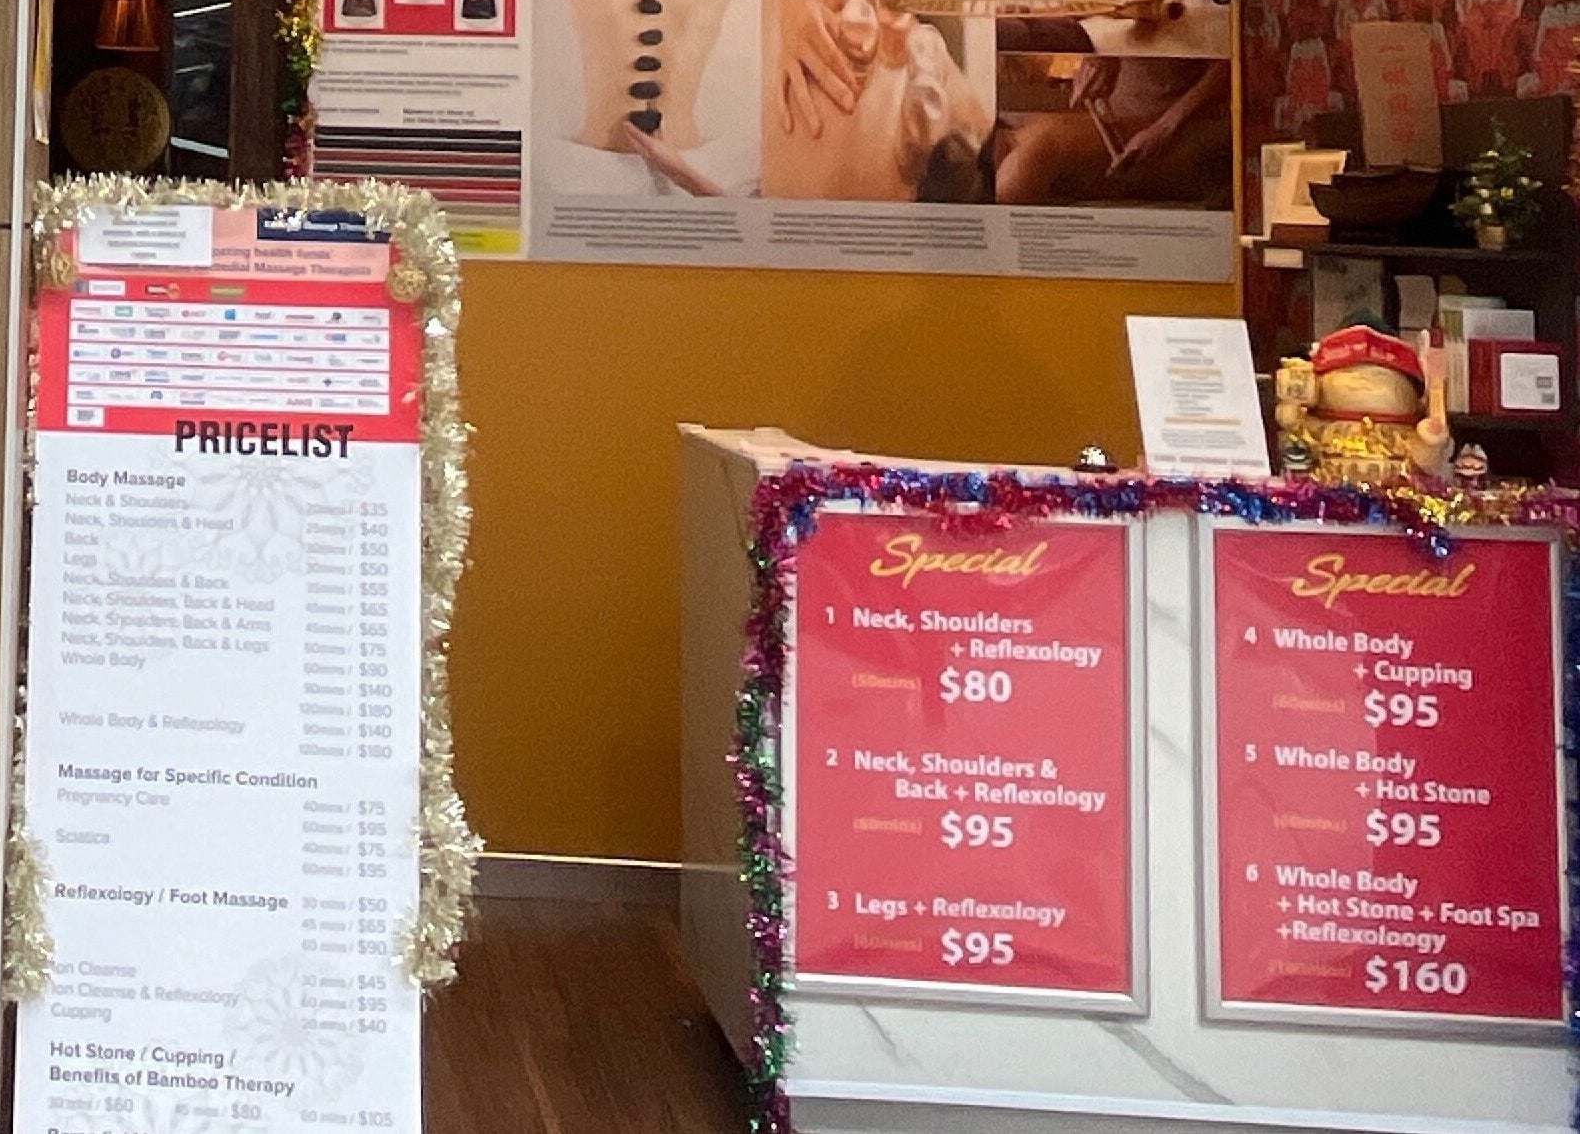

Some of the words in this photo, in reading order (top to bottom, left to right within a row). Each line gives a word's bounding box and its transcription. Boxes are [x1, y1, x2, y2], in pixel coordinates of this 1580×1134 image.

[175, 420, 354, 458] PRICELIST
[66, 469, 109, 487] Body
[114, 471, 186, 488] Massage
[870, 533, 1048, 589] Special
[1291, 552, 1476, 609] Special
[826, 607, 834, 624] 1
[853, 607, 916, 633] Neck,
[920, 610, 1034, 634] Shoulders
[950, 643, 964, 657] +
[970, 639, 1102, 668] Reflexology
[1244, 626, 1257, 643] 4
[1273, 628, 1347, 652] Whole
[1354, 632, 1413, 659] Body
[940, 666, 1012, 703] $80
[1353, 663, 1367, 679] +
[1374, 660, 1472, 689] Cupping
[1364, 689, 1439, 728] $95
[58, 764, 132, 784] Massage
[137, 767, 160, 782] for
[165, 768, 232, 786] Specific
[235, 771, 318, 788] Condition
[826, 749, 838, 766] 2
[854, 750, 916, 775] Neck,
[921, 752, 1035, 779] Shoulders
[1040, 759, 1058, 779] &
[1245, 744, 1257, 762] 5
[1274, 745, 1349, 770] Whole
[1356, 750, 1415, 779] Body
[57, 788, 133, 808] Pregnancy
[135, 790, 171, 806] Care
[895, 779, 948, 799] Back
[955, 787, 968, 800] +
[974, 782, 1106, 812] Reflexology
[1355, 783, 1369, 798] +
[1376, 779, 1419, 802] Hot
[1423, 781, 1490, 805] Stone
[940, 810, 1014, 850] $95
[1365, 809, 1441, 847] $95
[54, 883, 154, 906] Reflexology
[170, 888, 208, 906] Foot
[212, 891, 289, 911] Massage
[1246, 864, 1258, 881] 6
[1276, 865, 1350, 890] Whole
[1357, 871, 1418, 898] Body
[827, 891, 840, 910] 3
[855, 893, 908, 920] Legs
[914, 901, 927, 916] +
[932, 897, 1066, 928] Reflexology
[1276, 897, 1291, 912] +
[1297, 895, 1339, 917] Hot
[1346, 897, 1413, 921] Stone
[1420, 907, 1434, 922] +
[1440, 903, 1493, 925] Foot
[1497, 905, 1539, 931] Spa
[940, 927, 1014, 966] $95
[1365, 954, 1468, 993] $160
[50, 1041, 81, 1058] Hot
[85, 1043, 135, 1060] Stone
[151, 1047, 224, 1068] Cupping
[49, 1065, 120, 1085] Benefits
[124, 1070, 142, 1085] of
[147, 1071, 219, 1090] Bamboo
[223, 1075, 295, 1097] Therapy
